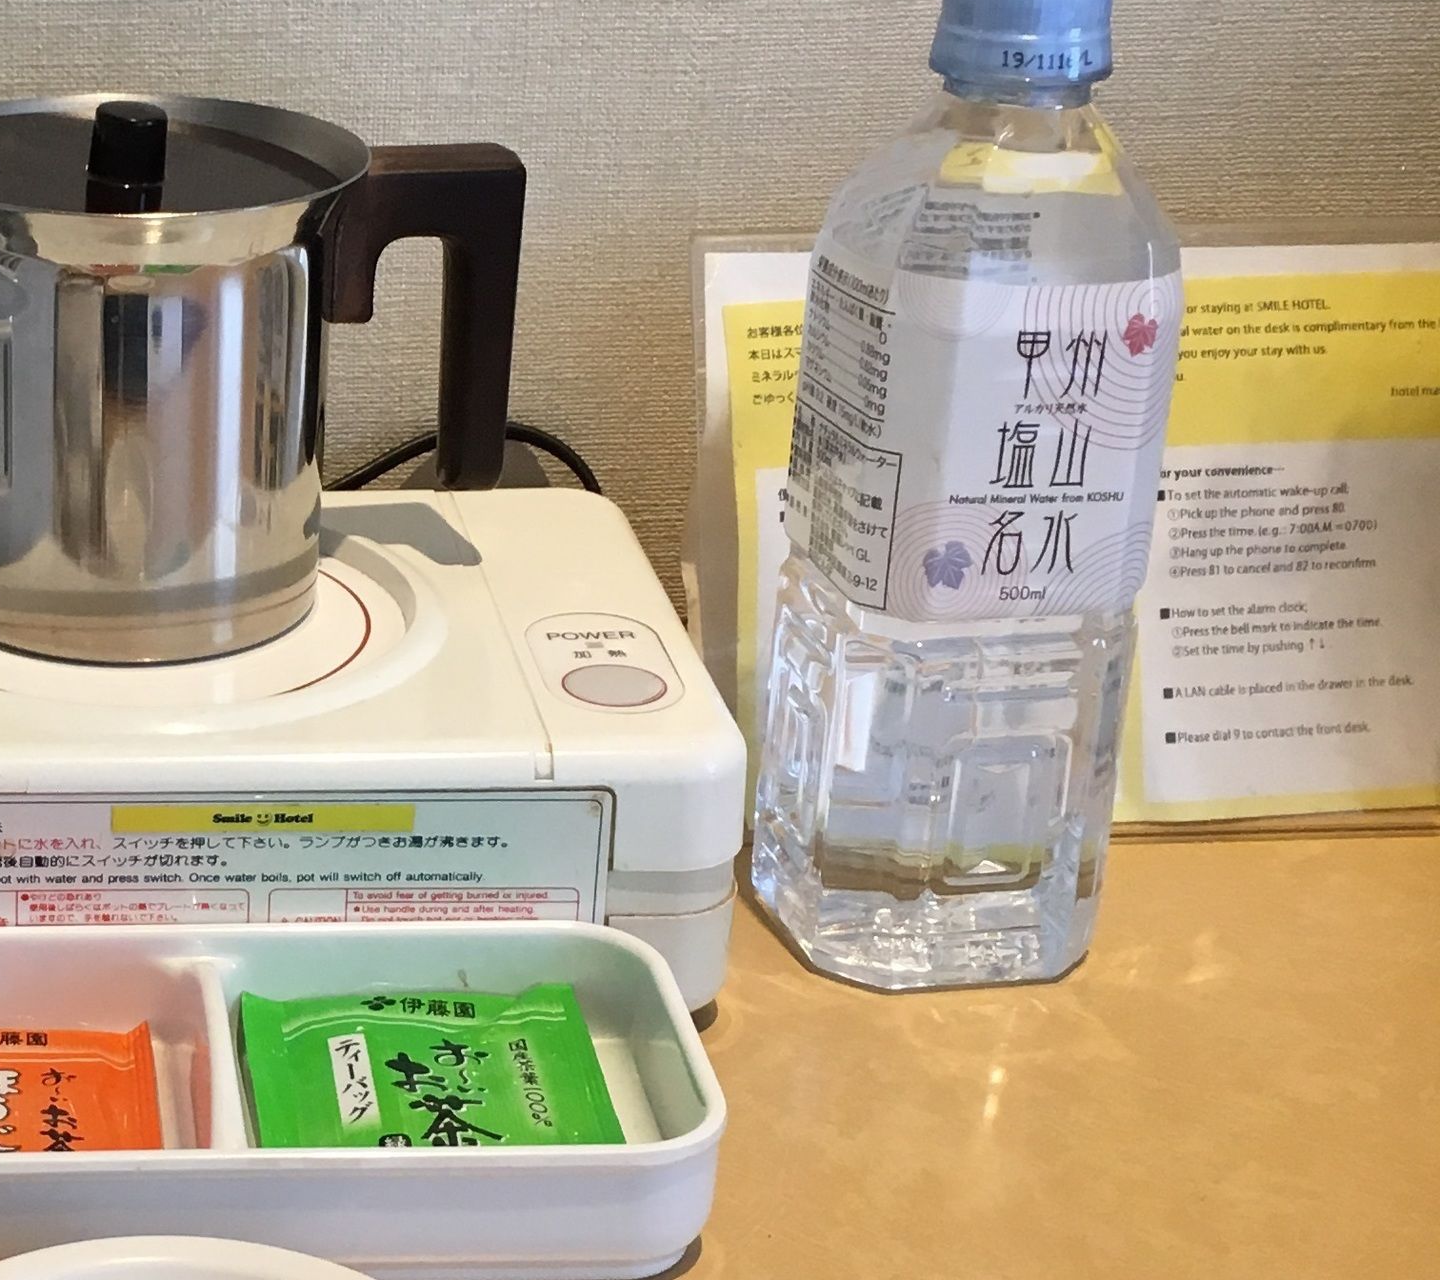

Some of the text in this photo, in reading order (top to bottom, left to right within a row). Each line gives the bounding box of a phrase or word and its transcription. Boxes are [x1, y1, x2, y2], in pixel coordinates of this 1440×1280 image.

[1186, 305, 1197, 314] or
[1200, 303, 1241, 315] staying
[1244, 303, 1254, 312] at
[1257, 300, 1289, 311] SMILE
[1192, 326, 1223, 336] water
[1227, 326, 1241, 335] on
[1243, 325, 1261, 334] the
[1264, 323, 1290, 333] desk
[1292, 323, 1301, 332] is
[1303, 321, 1386, 334] complimentary
[1389, 319, 1415, 329] from
[1417, 319, 1436, 329] the
[1178, 344, 1310, 361] you enjoy your stay with
[1016, 329, 1108, 399] 甲州
[752, 370, 799, 383] ミネラル
[1013, 402, 1089, 415] アルカリ天然水
[989, 419, 1092, 489] 塩山
[1160, 468, 1202, 481] or your
[949, 492, 1125, 504] Natural Mineral Water from KOSHU
[1167, 485, 1328, 501] To set the automatic wake-up
[1205, 505, 1330, 520] up the phone and press
[1210, 526, 1226, 537] the
[981, 510, 1078, 576] 名水
[1210, 547, 1224, 558] up
[1226, 544, 1244, 555] the
[1246, 544, 1282, 557] phone
[1284, 544, 1296, 553] to
[1224, 565, 1235, 575] to
[1237, 562, 1271, 574] cancel
[1273, 562, 1294, 573] and
[1312, 561, 1323, 570] to
[999, 586, 1047, 601] 500ml
[1171, 603, 1276, 618] How to set the alarm
[1212, 624, 1229, 635] the
[1230, 623, 1250, 635] bell
[1252, 622, 1277, 633] mark
[1279, 622, 1291, 631] to
[1293, 620, 1335, 631] indicate
[1337, 618, 1354, 629] the
[546, 631, 637, 641] POWER
[1202, 640, 1304, 655] the time by pushing
[1175, 687, 1183, 698] A
[1185, 686, 1206, 697] LAN
[1209, 684, 1236, 696] cable
[1238, 684, 1247, 694] is
[1249, 681, 1283, 696] placed
[1285, 682, 1295, 691] in
[1298, 680, 1315, 691] the
[1317, 679, 1353, 690] drawer
[1368, 677, 1386, 688] the
[1177, 731, 1210, 743] Please
[1213, 729, 1231, 741] dial
[1233, 728, 1241, 739] 9
[1243, 730, 1254, 740] to
[1256, 727, 1294, 739] contact
[1297, 724, 1314, 736] the
[1316, 723, 1342, 735] front
[212, 813, 314, 823] Smile Hotel
[17, 873, 41, 884] with
[45, 874, 77, 883] water
[82, 873, 104, 883] and
[108, 874, 139, 886] press
[189, 873, 220, 883] Once
[225, 874, 256, 883] water
[297, 873, 315, 885] pot
[320, 872, 339, 882] will
[344, 872, 382, 882] switch
[386, 872, 401, 882] off
[353, 891, 364, 900] To
[367, 891, 393, 900] avoid
[396, 891, 414, 900] fear
[418, 891, 427, 899] of
[431, 891, 463, 902] getting
[467, 891, 499, 900] burned
[362, 905, 380, 913] Use
[384, 905, 416, 913] handle
[419, 905, 448, 915] during
[452, 905, 470, 913] and
[473, 905, 494, 913] after
[399, 996, 476, 1019] 伊藤園
[335, 1039, 373, 1125] ティーバッグ
